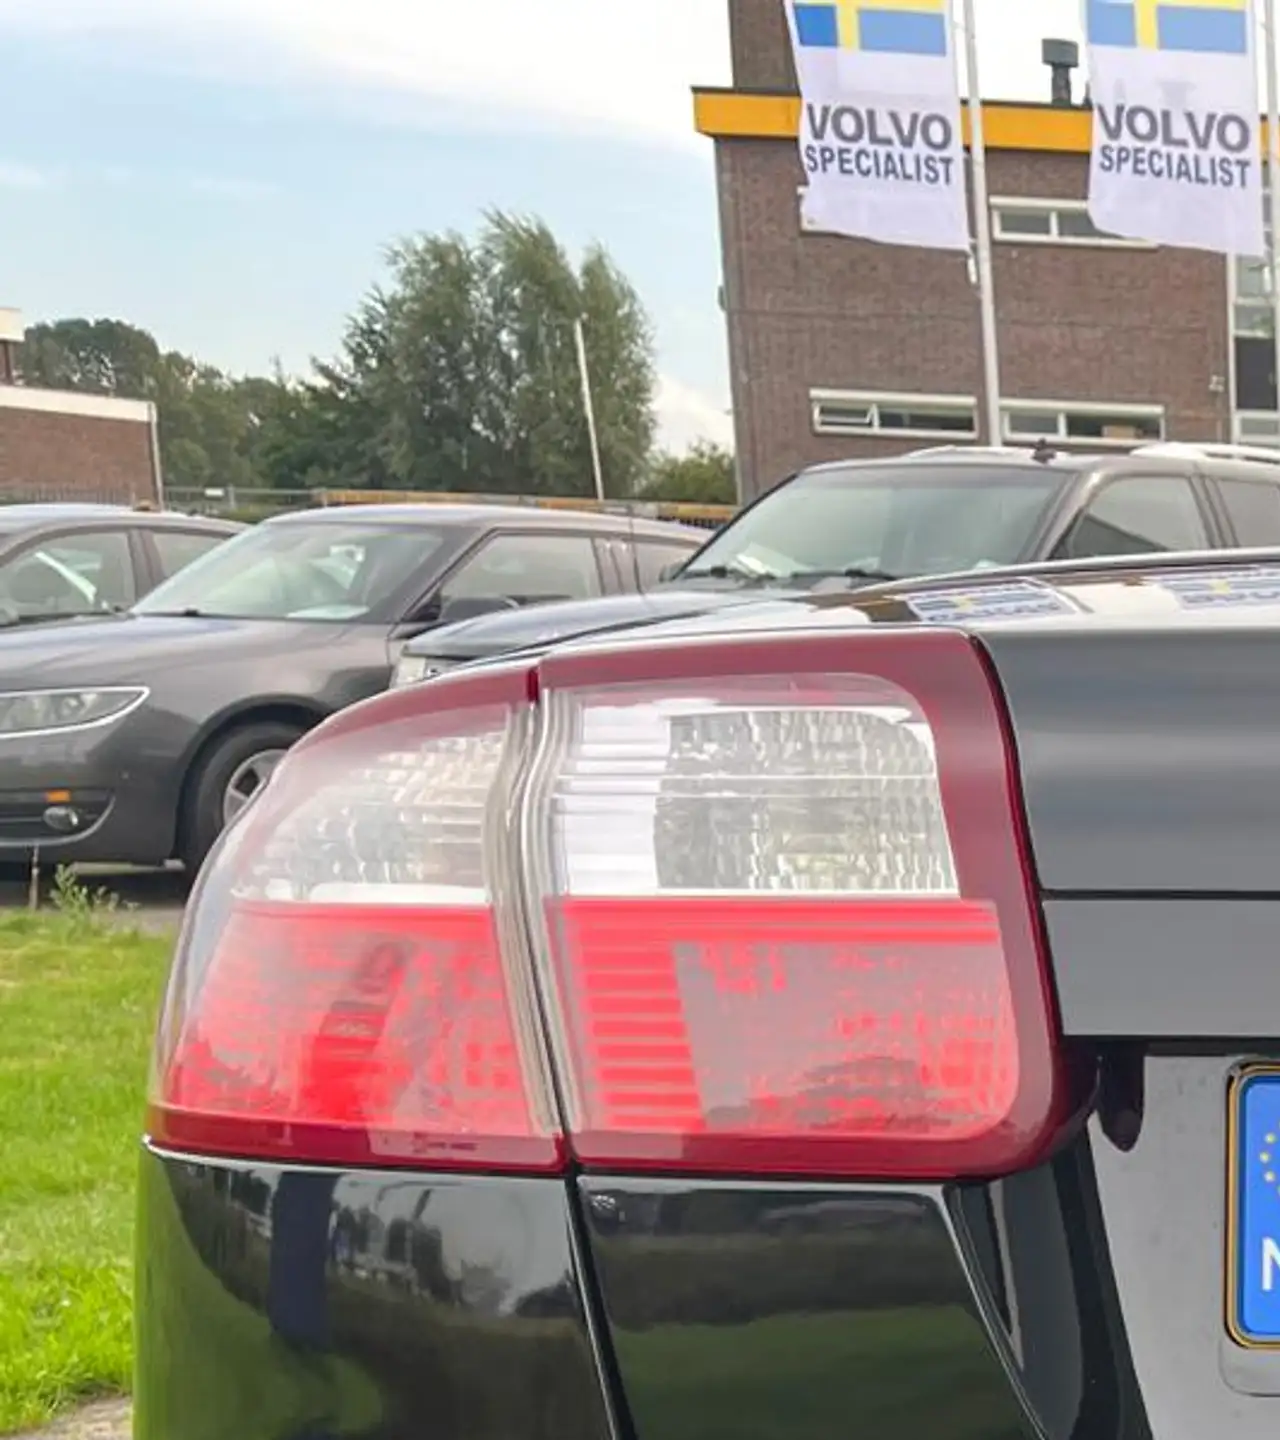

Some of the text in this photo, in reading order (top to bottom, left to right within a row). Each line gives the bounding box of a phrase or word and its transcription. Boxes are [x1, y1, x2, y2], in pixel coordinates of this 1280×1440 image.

[806, 103, 952, 151] VOLVO
[1097, 103, 1250, 153] VOLVO
[804, 143, 954, 185] SPECIALIST
[1099, 144, 1252, 188] SPECIALIST
